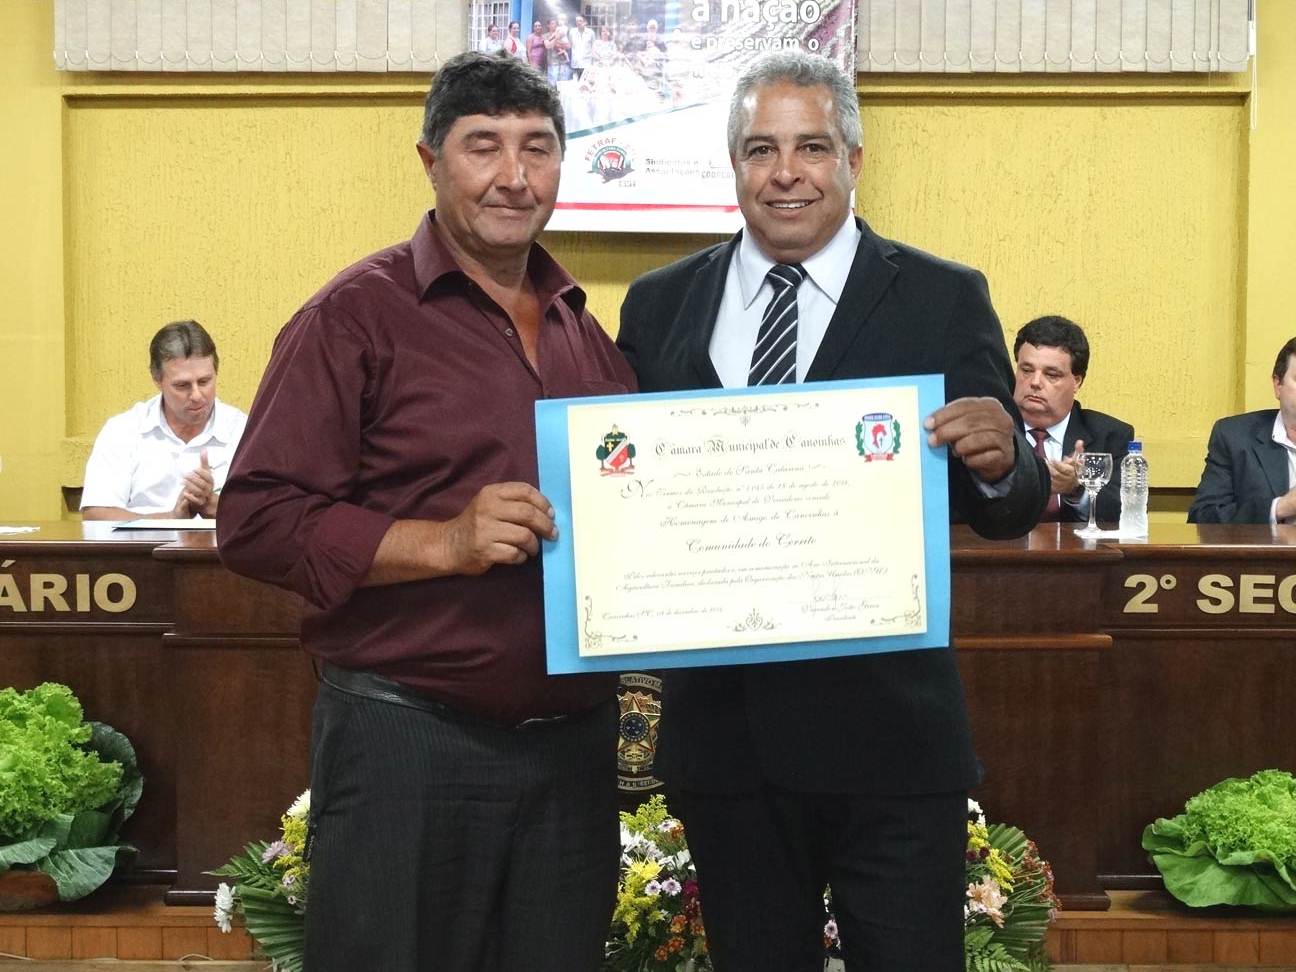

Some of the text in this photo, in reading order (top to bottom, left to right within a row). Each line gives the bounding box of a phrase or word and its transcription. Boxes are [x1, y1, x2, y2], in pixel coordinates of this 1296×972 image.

[691, 36, 820, 52] e preservam o
